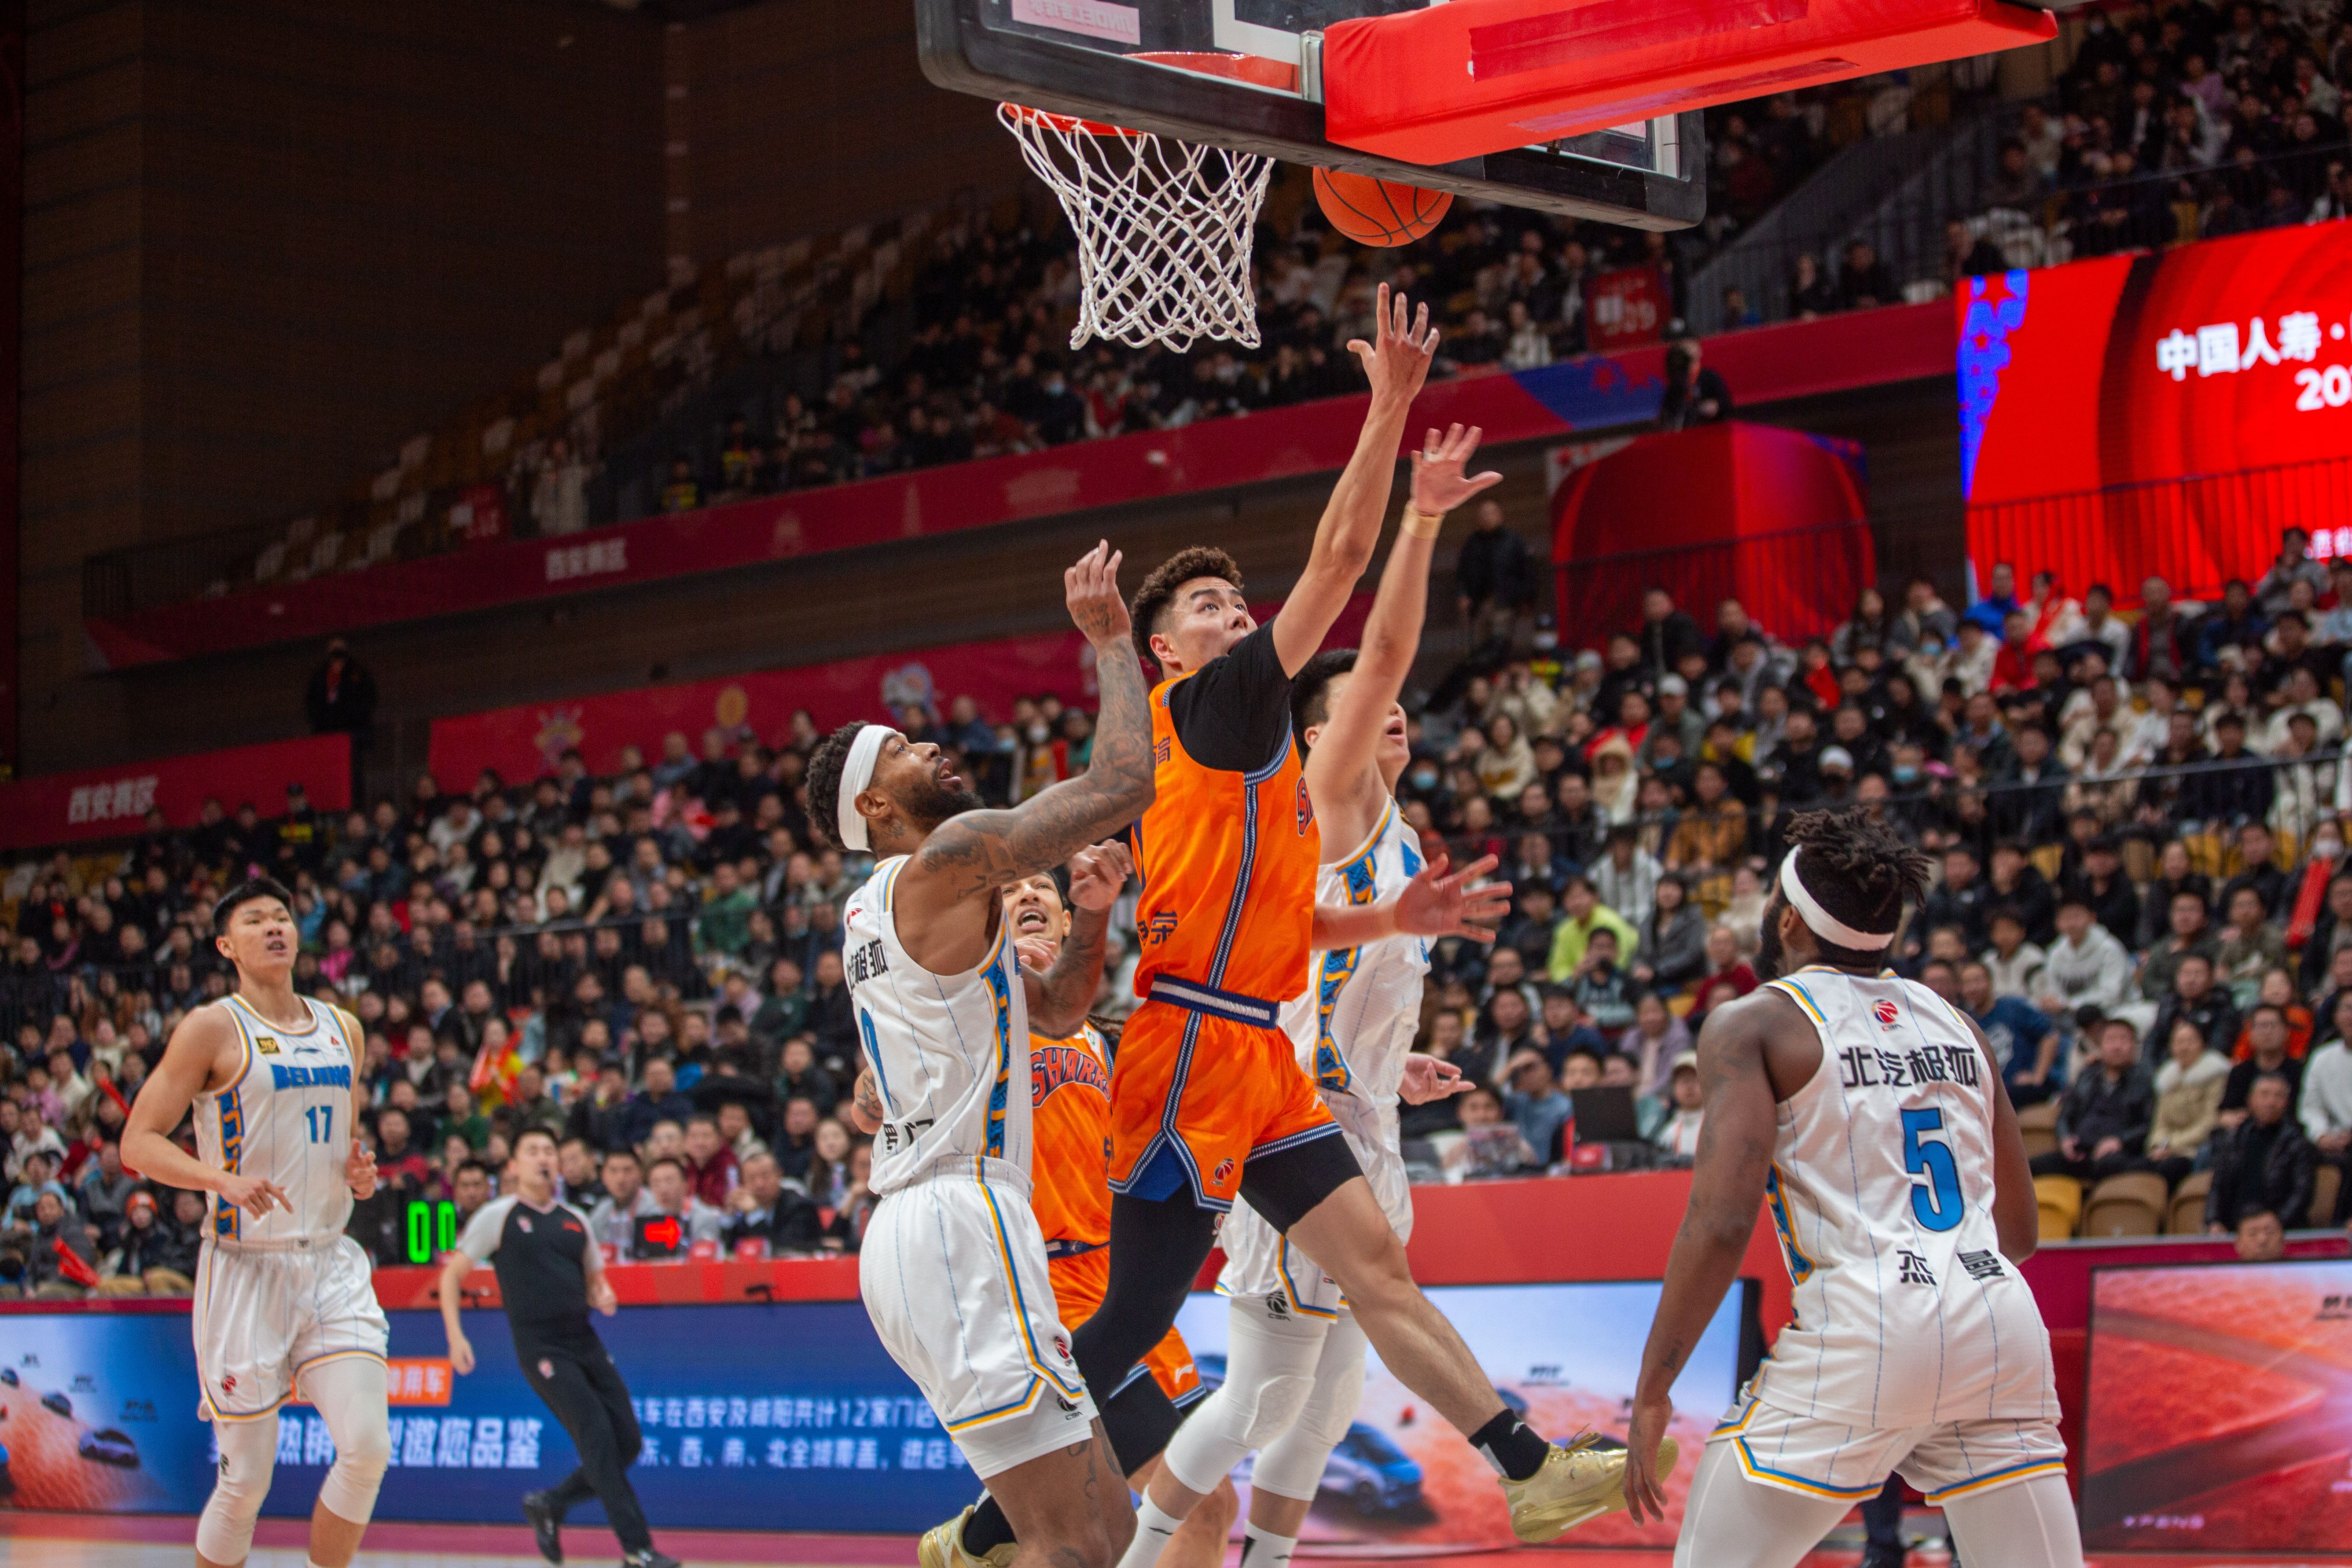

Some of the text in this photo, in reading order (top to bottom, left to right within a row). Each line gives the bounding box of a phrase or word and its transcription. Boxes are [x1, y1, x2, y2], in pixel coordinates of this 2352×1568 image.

[2157, 311, 2352, 382] 中国人寿·
[2294, 364, 2352, 411] 20
[1840, 1045, 1979, 1088] 北汽极狐
[305, 1105, 333, 1144] 17
[1901, 1108, 1965, 1231] 5
